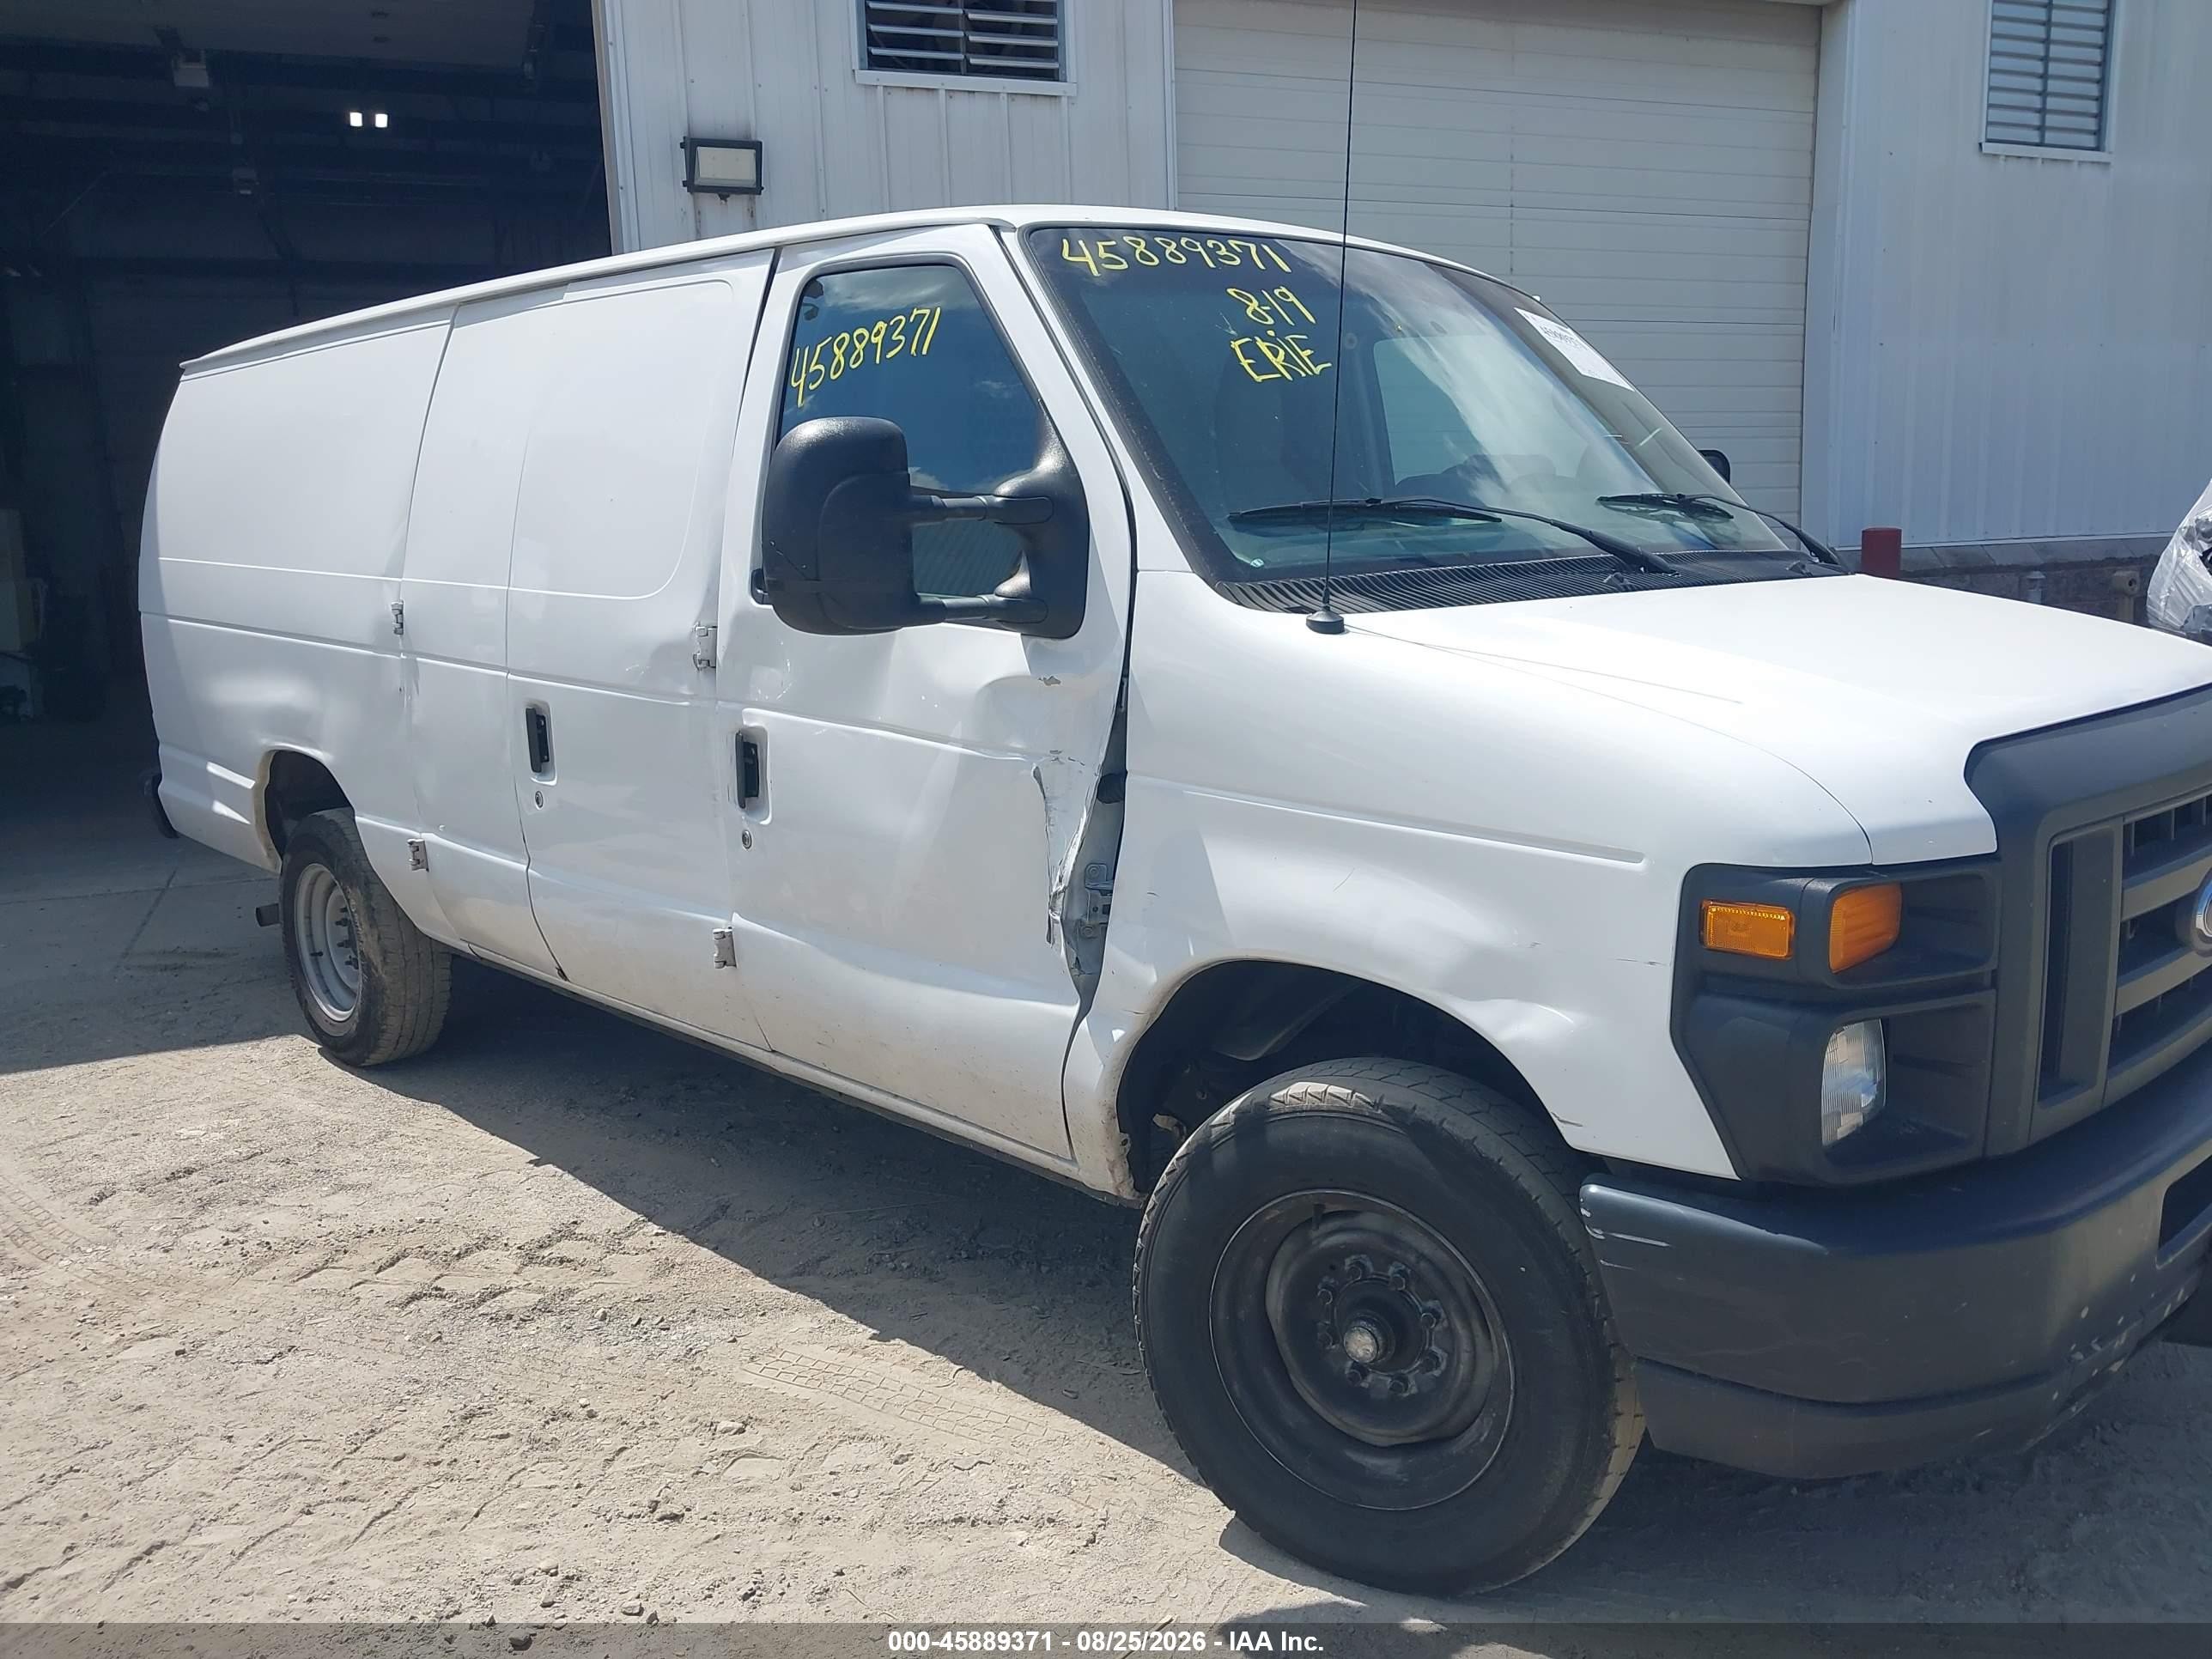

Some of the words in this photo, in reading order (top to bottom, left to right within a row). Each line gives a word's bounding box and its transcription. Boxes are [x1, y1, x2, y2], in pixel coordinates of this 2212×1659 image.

[1061, 235, 1291, 277] 45889371
[790, 307, 941, 409] 45889371
[1230, 330, 1332, 383] ERIE
